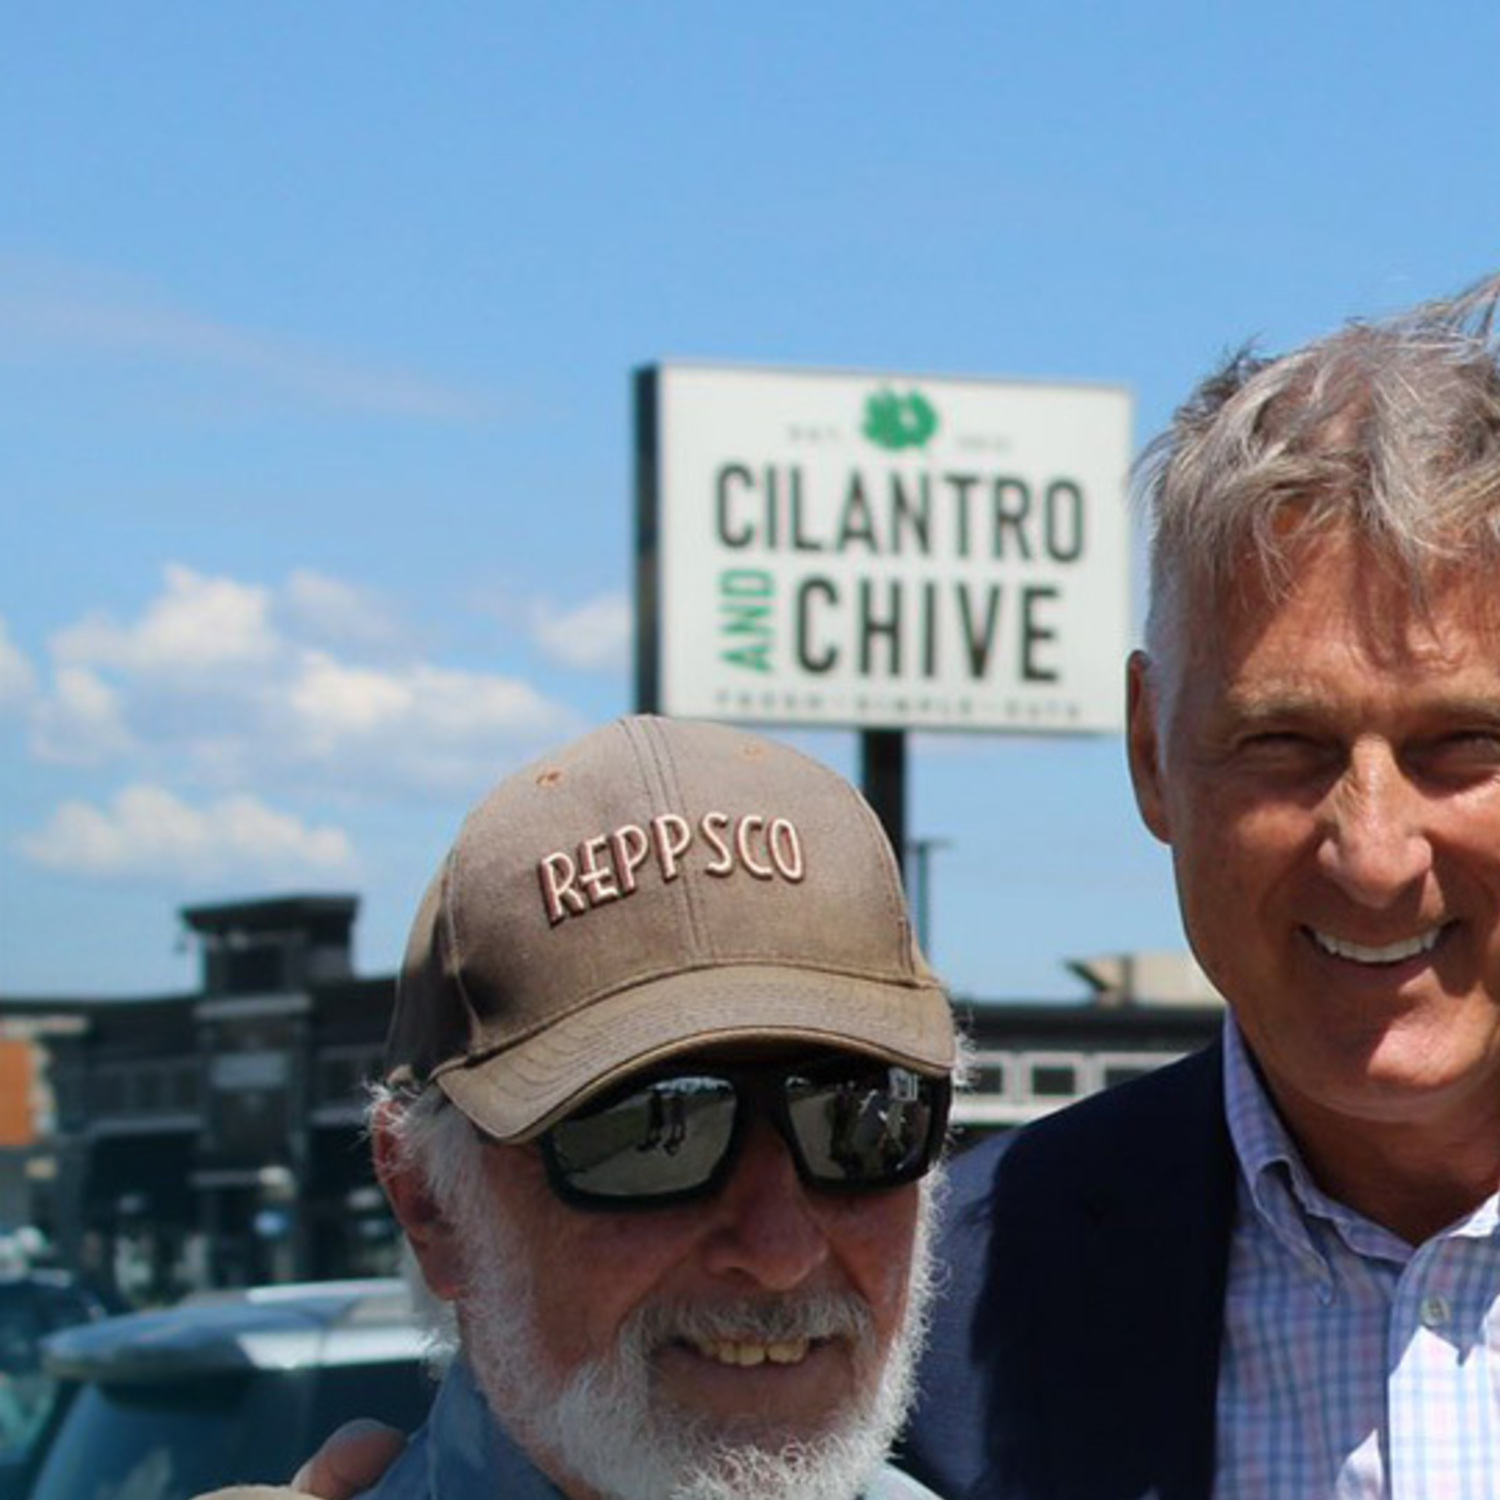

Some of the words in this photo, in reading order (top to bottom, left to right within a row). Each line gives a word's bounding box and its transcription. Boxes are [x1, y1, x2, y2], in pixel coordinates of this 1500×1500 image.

[715, 462, 1084, 564] CILANTRO
[719, 568, 774, 673] AND
[796, 573, 1060, 683] CHIVE
